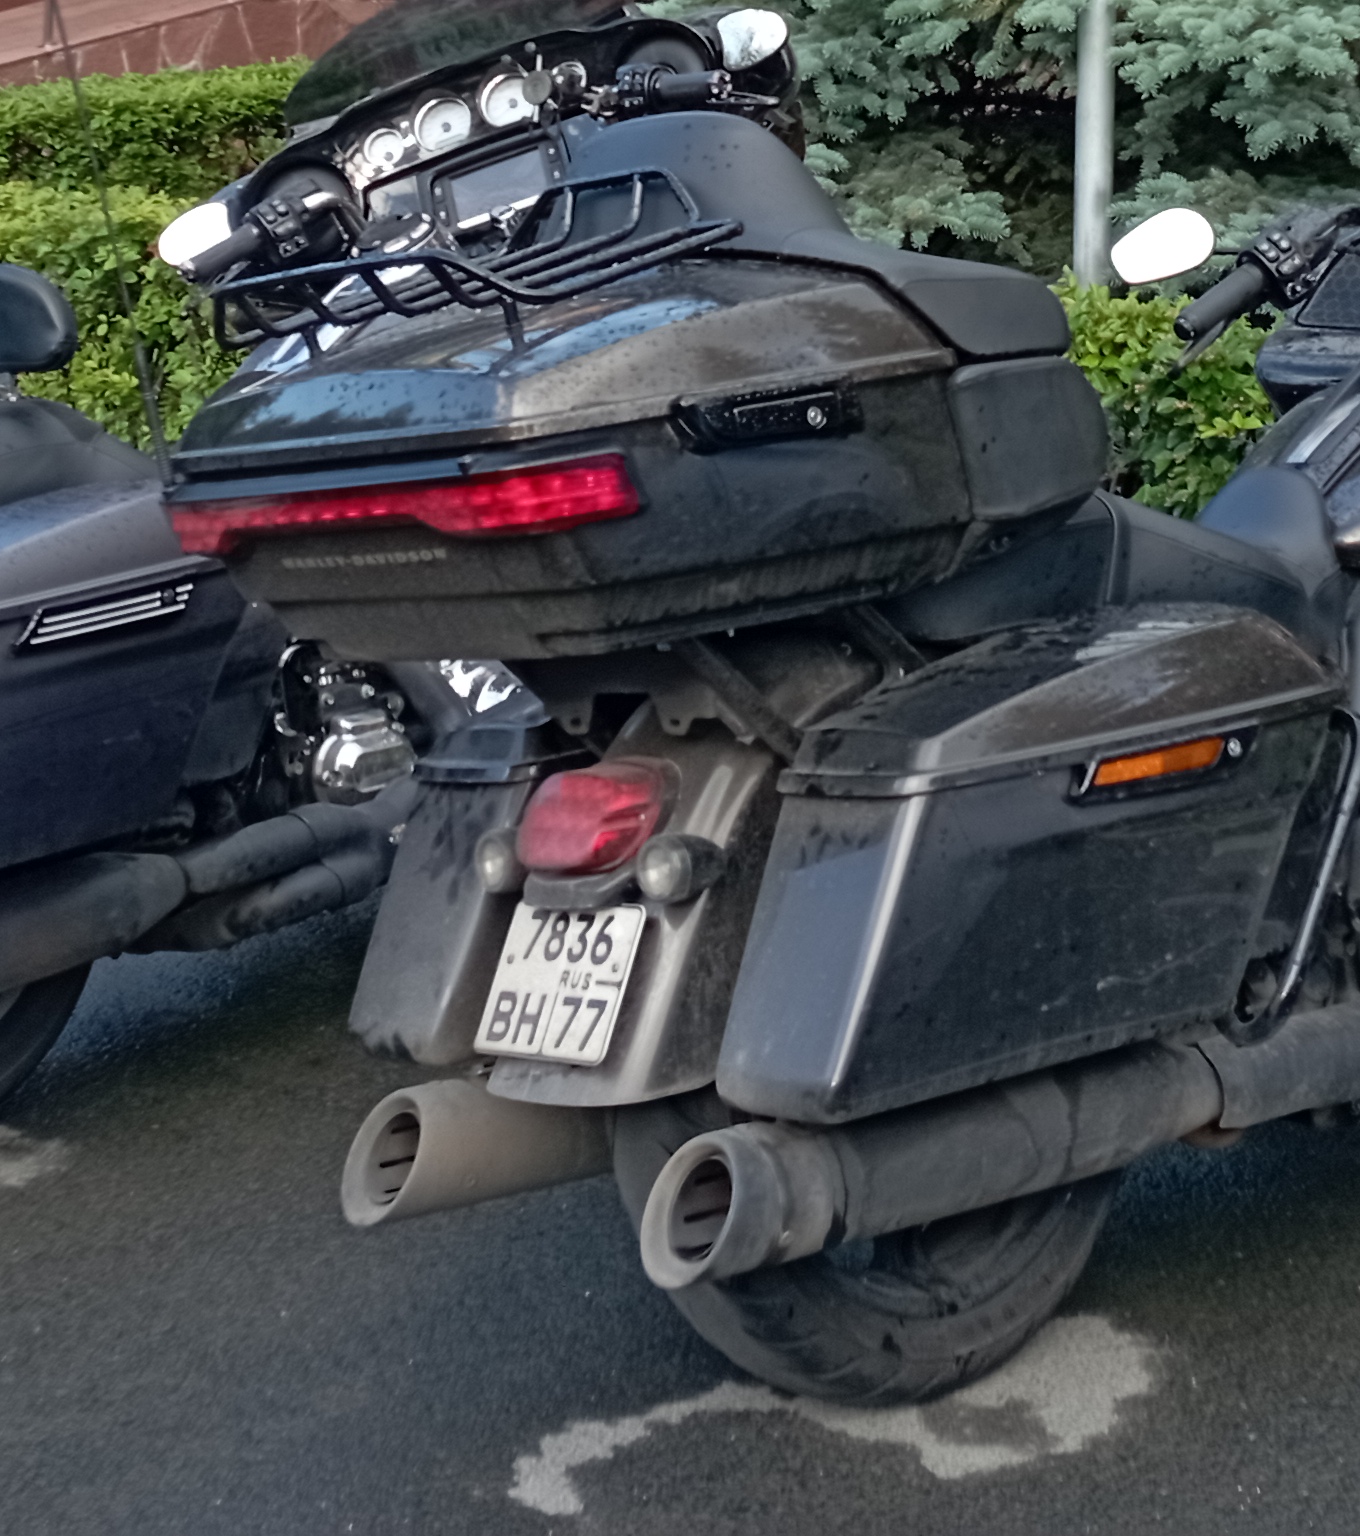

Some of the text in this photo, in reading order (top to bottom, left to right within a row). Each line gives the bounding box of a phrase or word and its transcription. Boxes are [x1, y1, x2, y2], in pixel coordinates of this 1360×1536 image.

[523, 910, 615, 965] 7836
[560, 970, 592, 990] RUS
[554, 996, 608, 1052] 77
